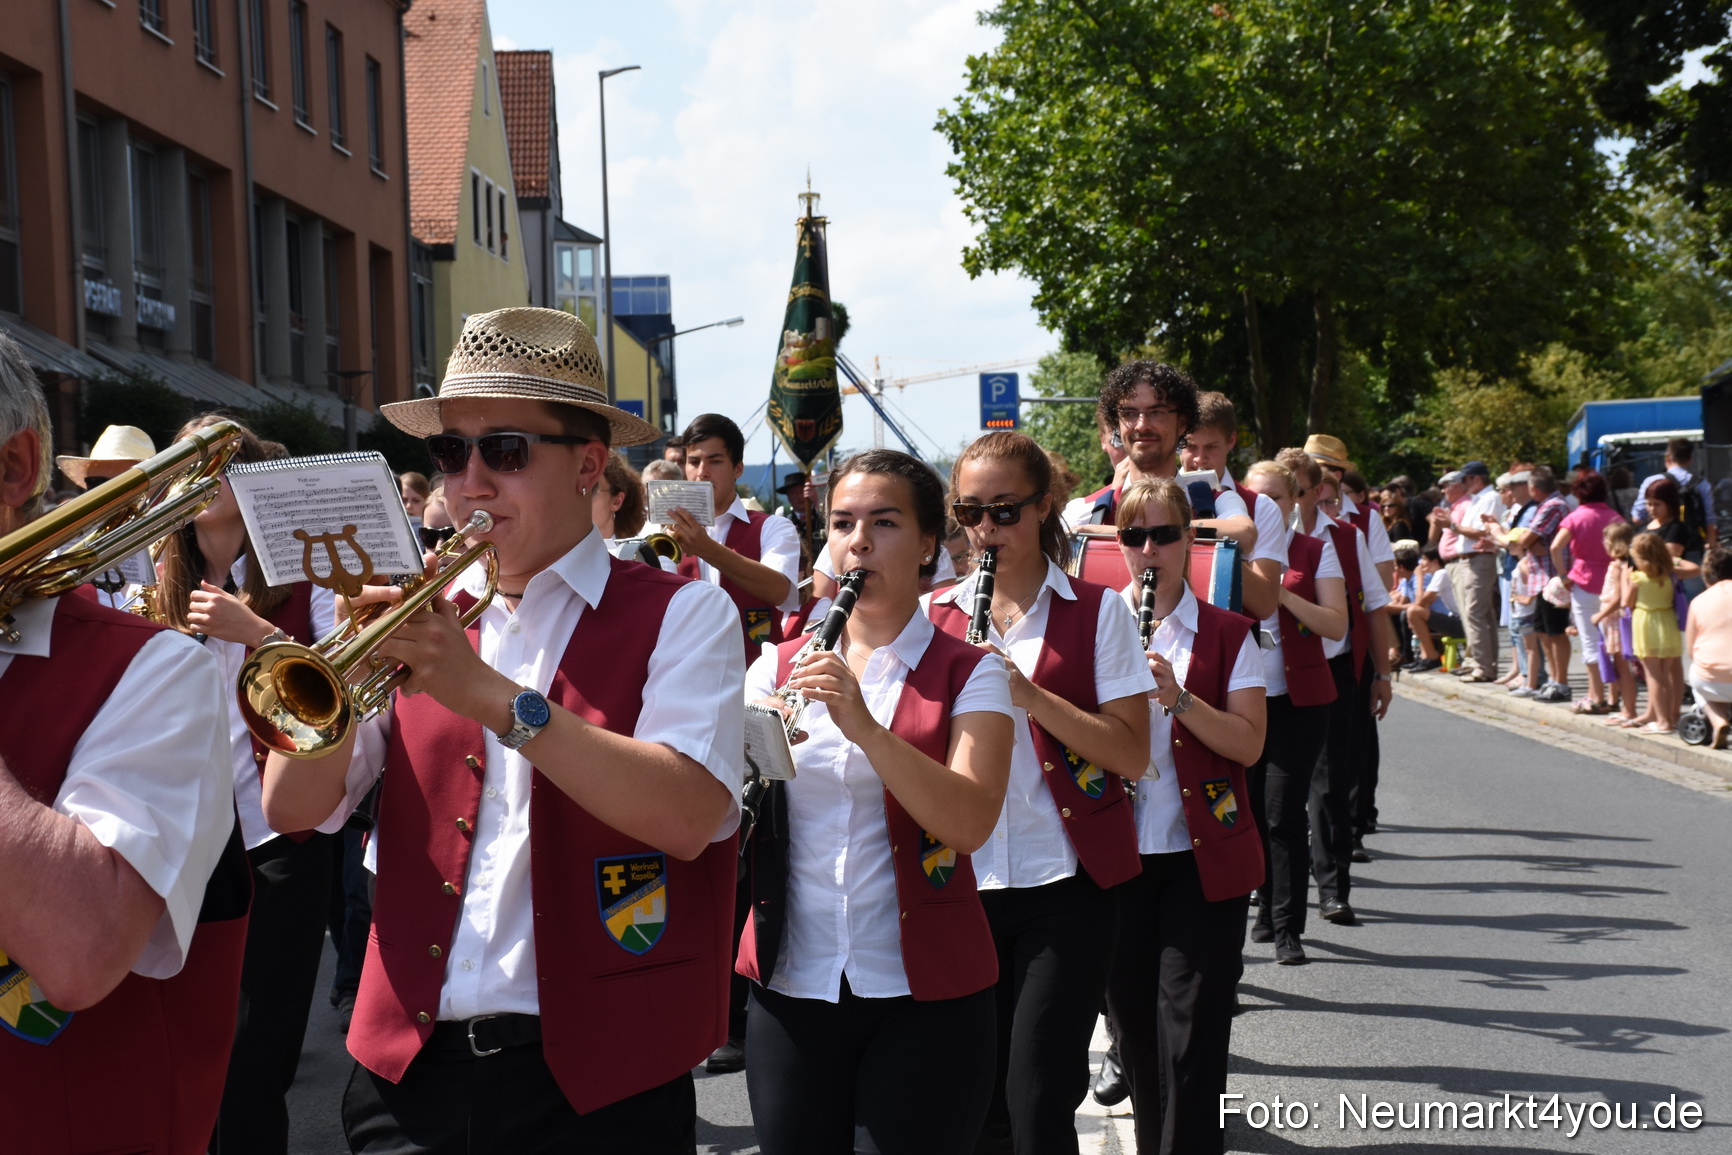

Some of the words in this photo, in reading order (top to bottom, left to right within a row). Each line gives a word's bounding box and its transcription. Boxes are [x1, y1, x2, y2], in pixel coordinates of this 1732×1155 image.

[992, 383, 1006, 402] P
[630, 861, 660, 872] Werkvolk
[631, 871, 656, 881] Kapelle
[607, 891, 640, 916] Neumarkt
